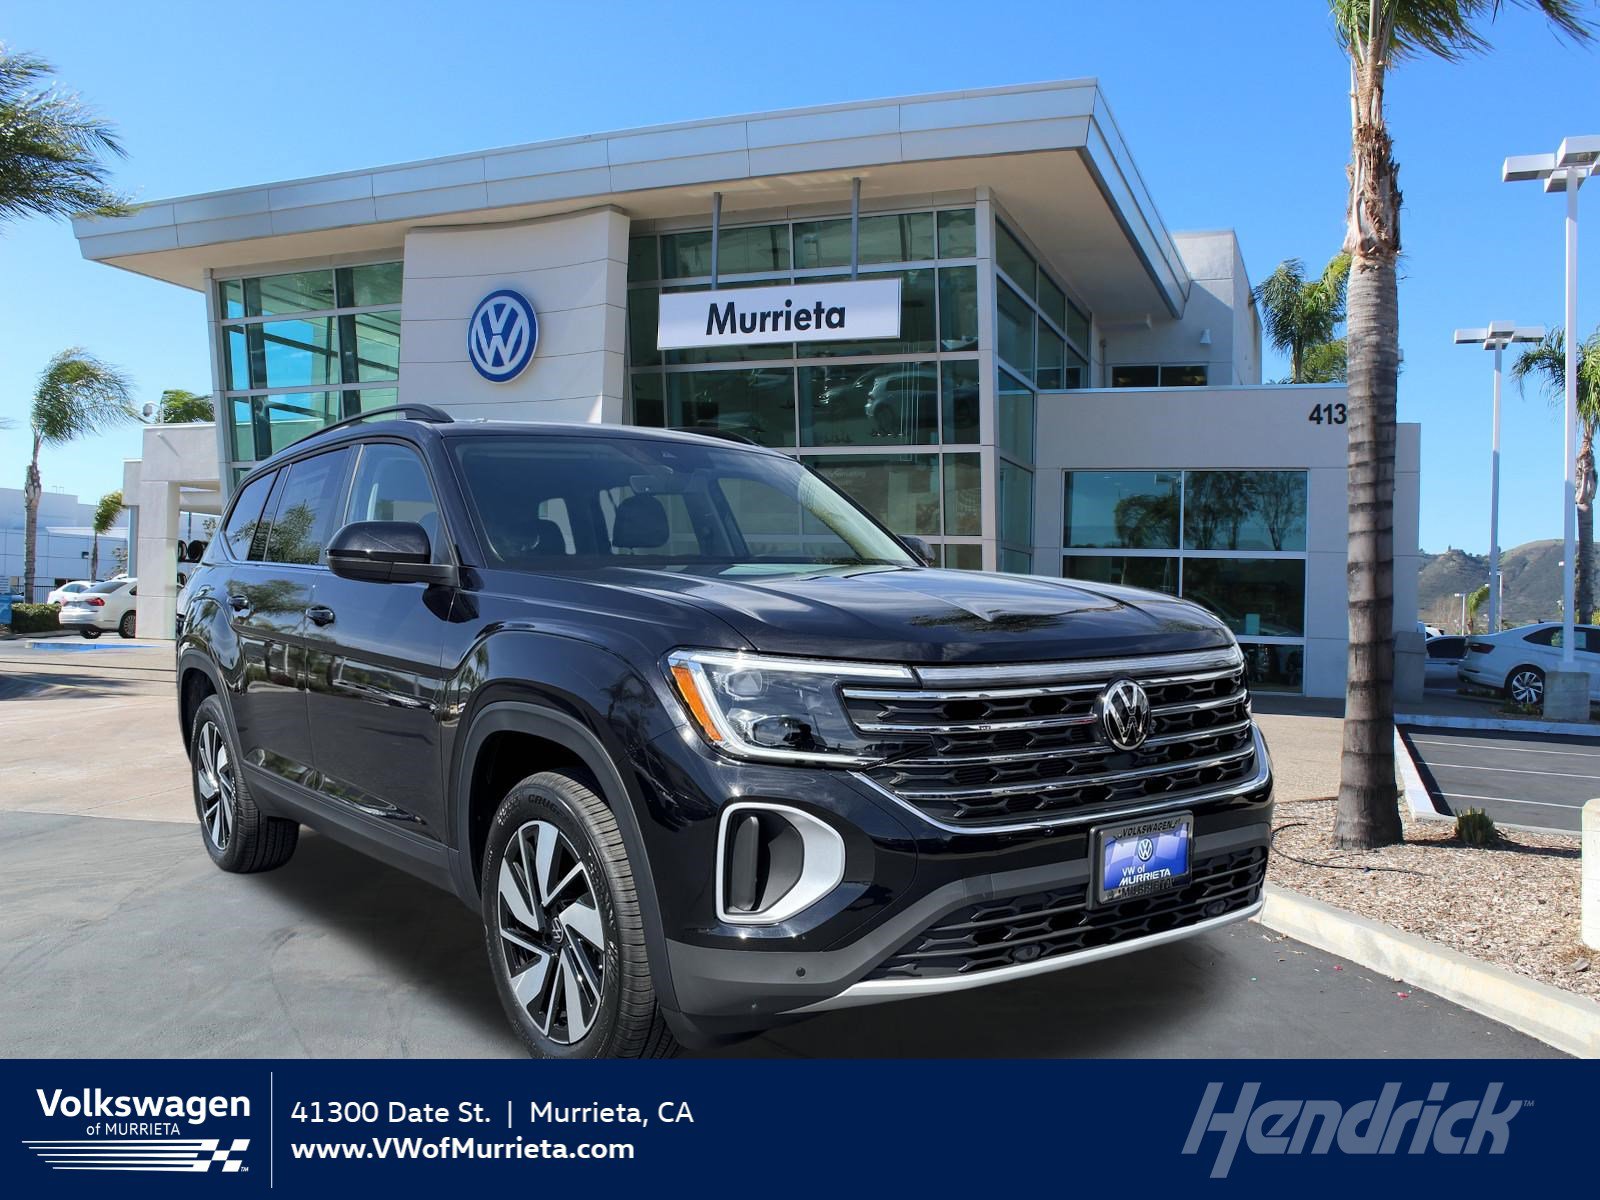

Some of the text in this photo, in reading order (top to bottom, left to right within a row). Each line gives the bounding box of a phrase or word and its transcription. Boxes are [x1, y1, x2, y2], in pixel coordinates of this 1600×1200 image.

[705, 299, 846, 335] Murrieta
[1308, 403, 1347, 425] 413
[1119, 868, 1171, 887] MURRIETA
